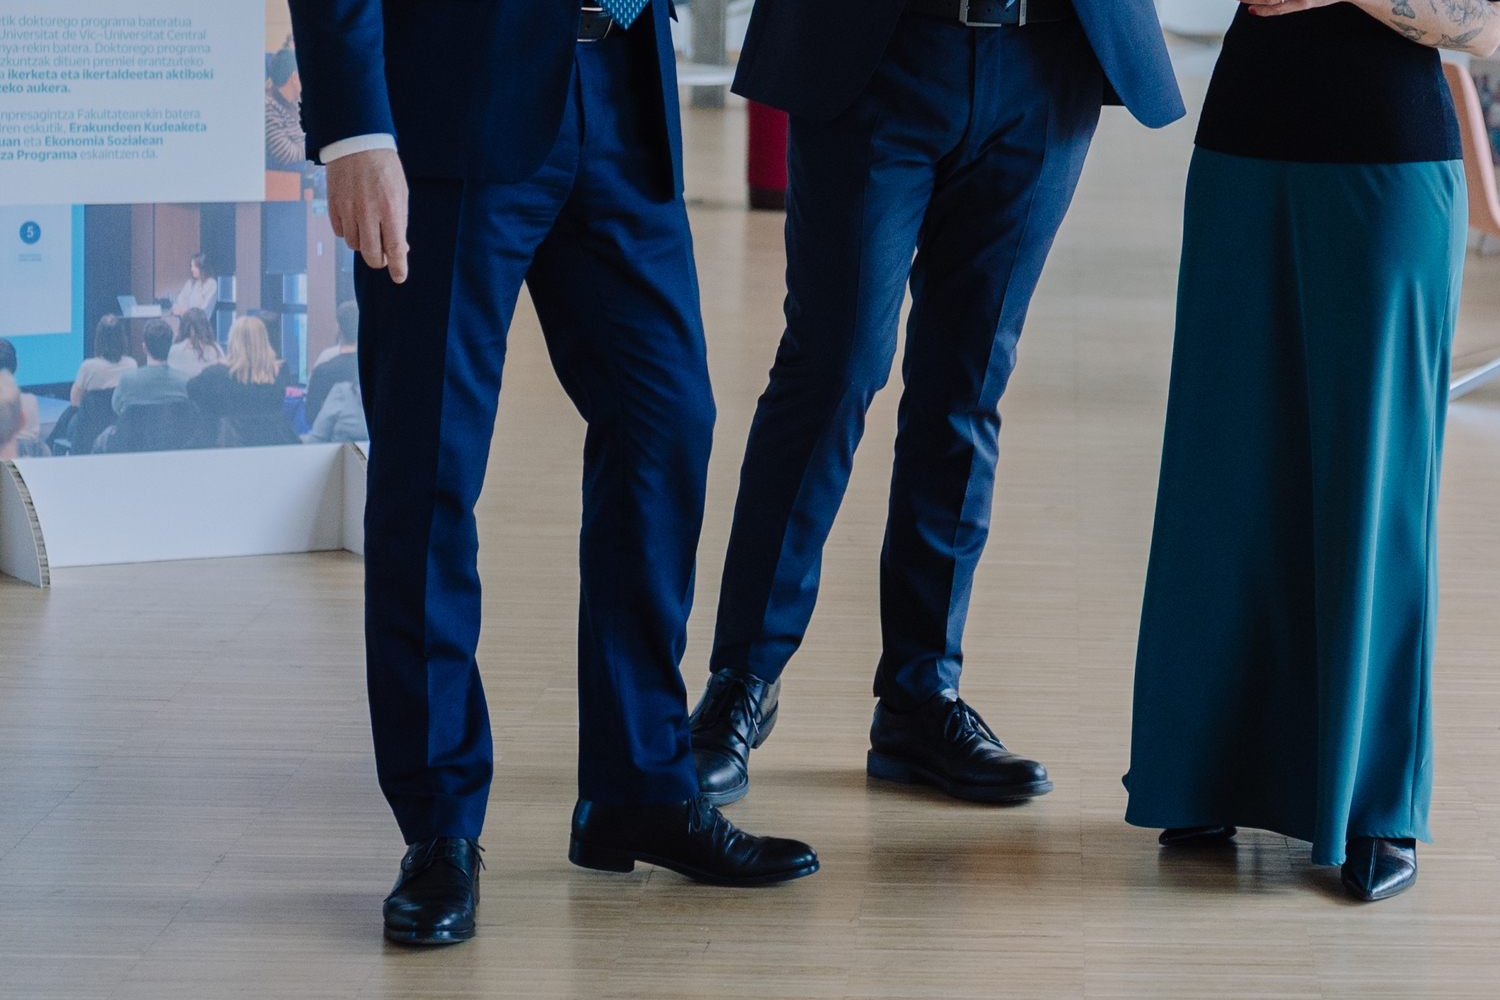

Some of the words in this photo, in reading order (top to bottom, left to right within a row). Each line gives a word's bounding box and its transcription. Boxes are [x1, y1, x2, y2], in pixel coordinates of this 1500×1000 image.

[18, 15, 78, 29] doktorego
[80, 16, 136, 29] programa
[138, 16, 192, 28] bateratua
[61, 28, 77, 40] de
[166, 28, 207, 41] Central
[52, 41, 92, 54] batera.
[94, 42, 154, 56] Doktorego
[156, 44, 211, 56] programa
[53, 54, 91, 67] dituen
[137, 56, 204, 68] erantzuteko
[8, 68, 58, 80] ikerketa
[60, 68, 80, 80] eta
[82, 67, 163, 80] ikertaldeetan
[165, 67, 214, 80] aktiboki
[0, 82, 24, 94] eko
[26, 82, 72, 94] aukera.
[77, 107, 162, 121] Fakultatearekin
[164, 107, 201, 120] batera
[69, 120, 142, 133] Erakundeen
[143, 121, 207, 133] Kudeaketa
[23, 136, 42, 148] eta
[44, 133, 105, 147] Ekonomia
[106, 134, 164, 147] Sozialean
[16, 148, 78, 163] Programa
[79, 147, 140, 161] eskaintzen
[141, 147, 159, 161] da.
